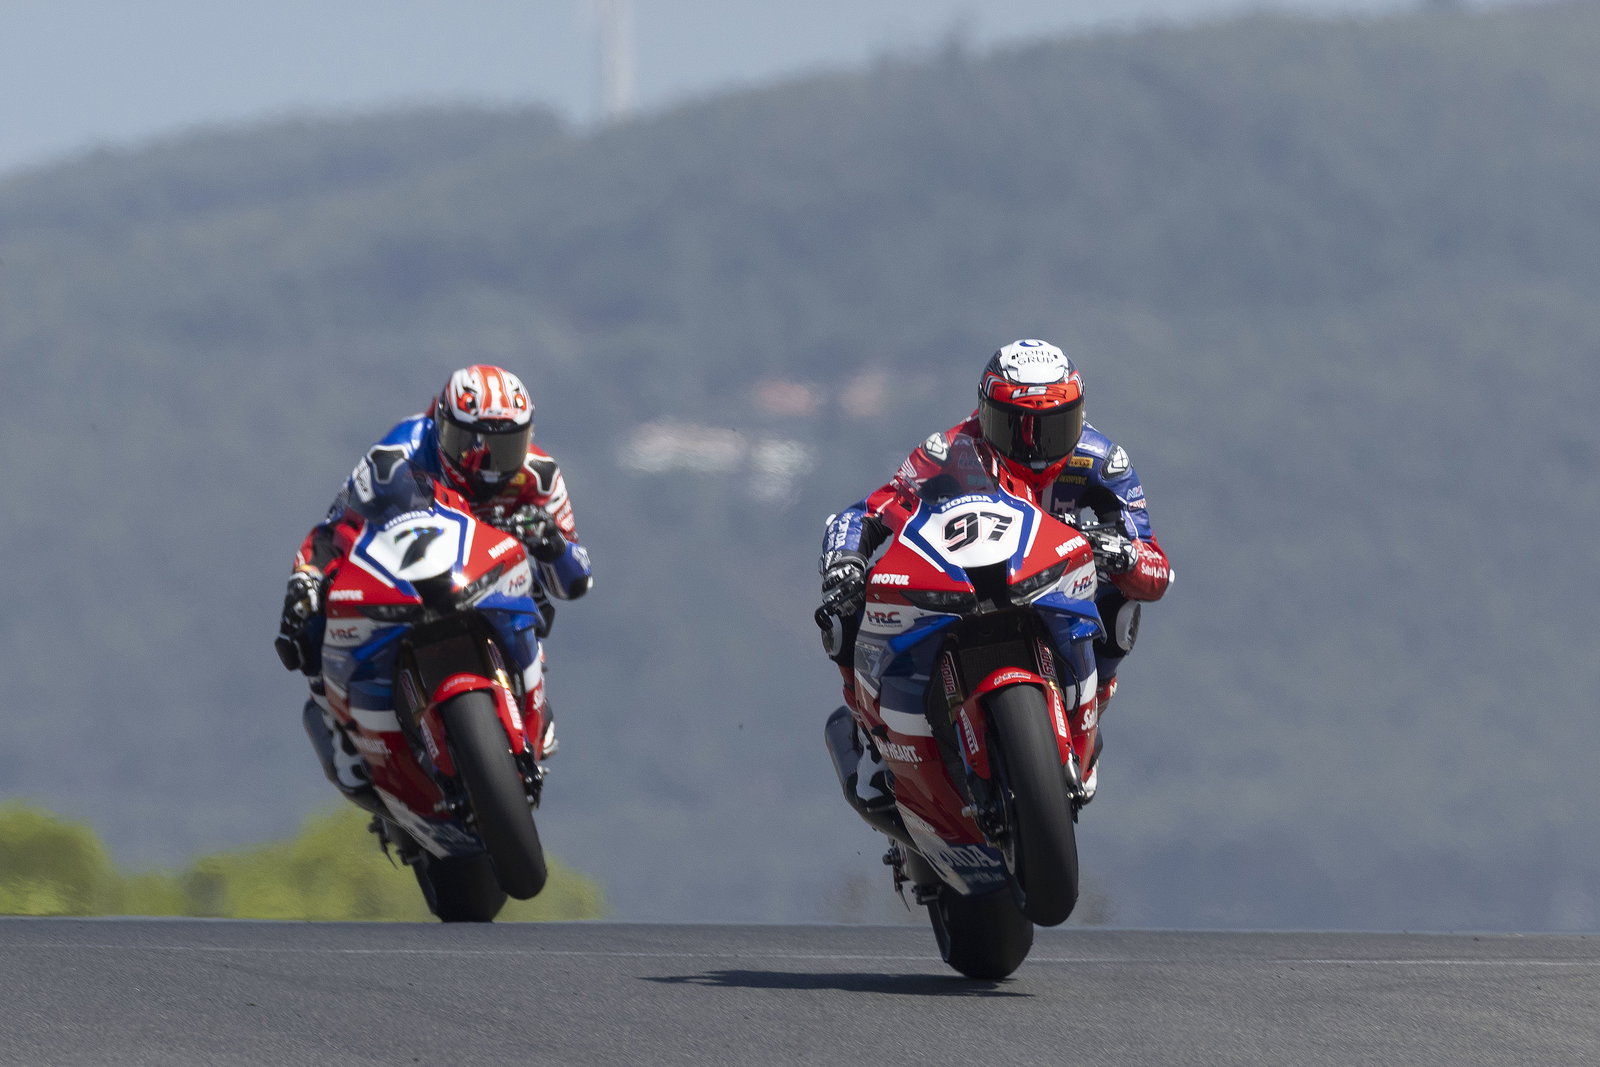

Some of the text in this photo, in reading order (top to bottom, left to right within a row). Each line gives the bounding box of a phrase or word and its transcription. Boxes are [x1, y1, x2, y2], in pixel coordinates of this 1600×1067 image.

[940, 494, 993, 512] HONDA
[943, 510, 1014, 554] 97
[394, 526, 445, 571] 7
[1055, 536, 1086, 557] MOTUL
[871, 574, 909, 585] MOTUL
[866, 610, 901, 623] HRC
